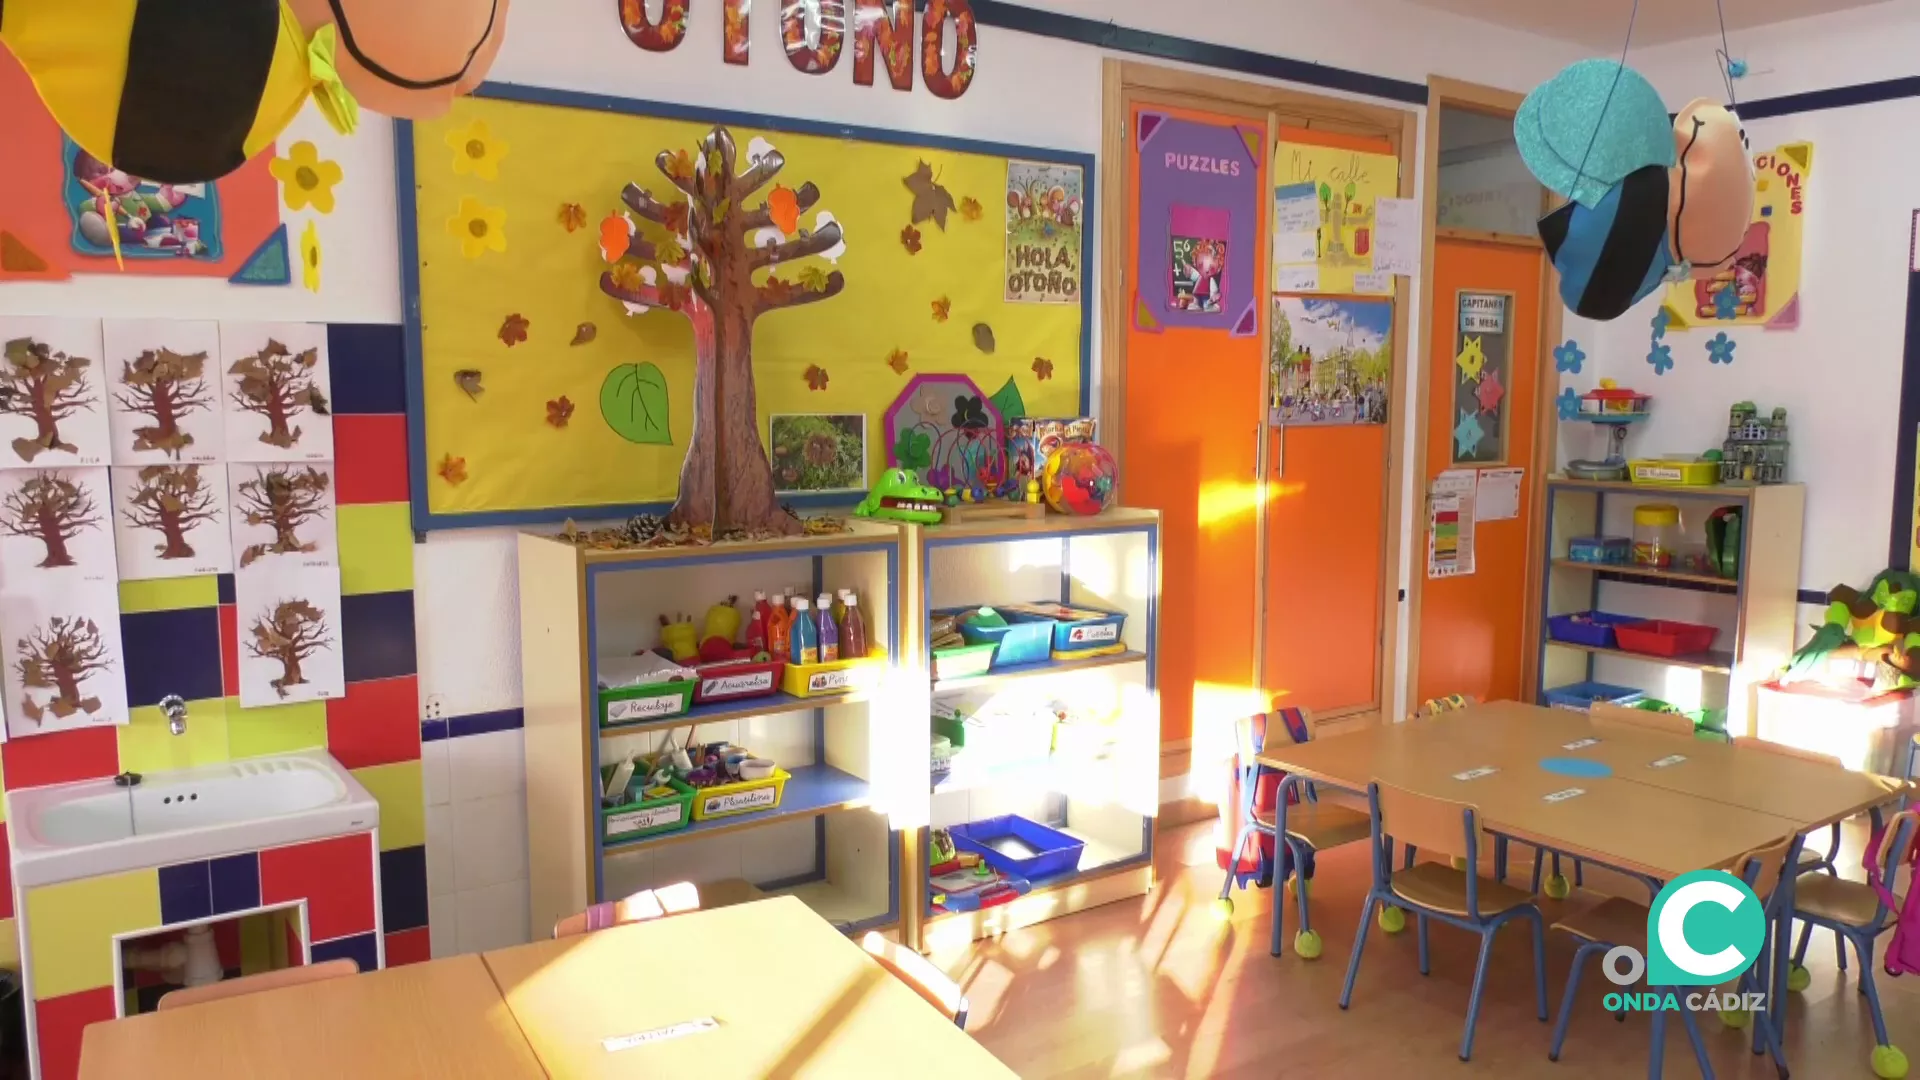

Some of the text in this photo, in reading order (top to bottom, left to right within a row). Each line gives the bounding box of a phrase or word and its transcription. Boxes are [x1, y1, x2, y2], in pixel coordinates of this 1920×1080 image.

[1164, 152, 1241, 177] PUZZLES
[1291, 149, 1371, 184] Mi calle
[1465, 316, 1499, 329] DE MESA
[631, 698, 675, 714] Reciclaje
[723, 792, 771, 808] Plastilina
